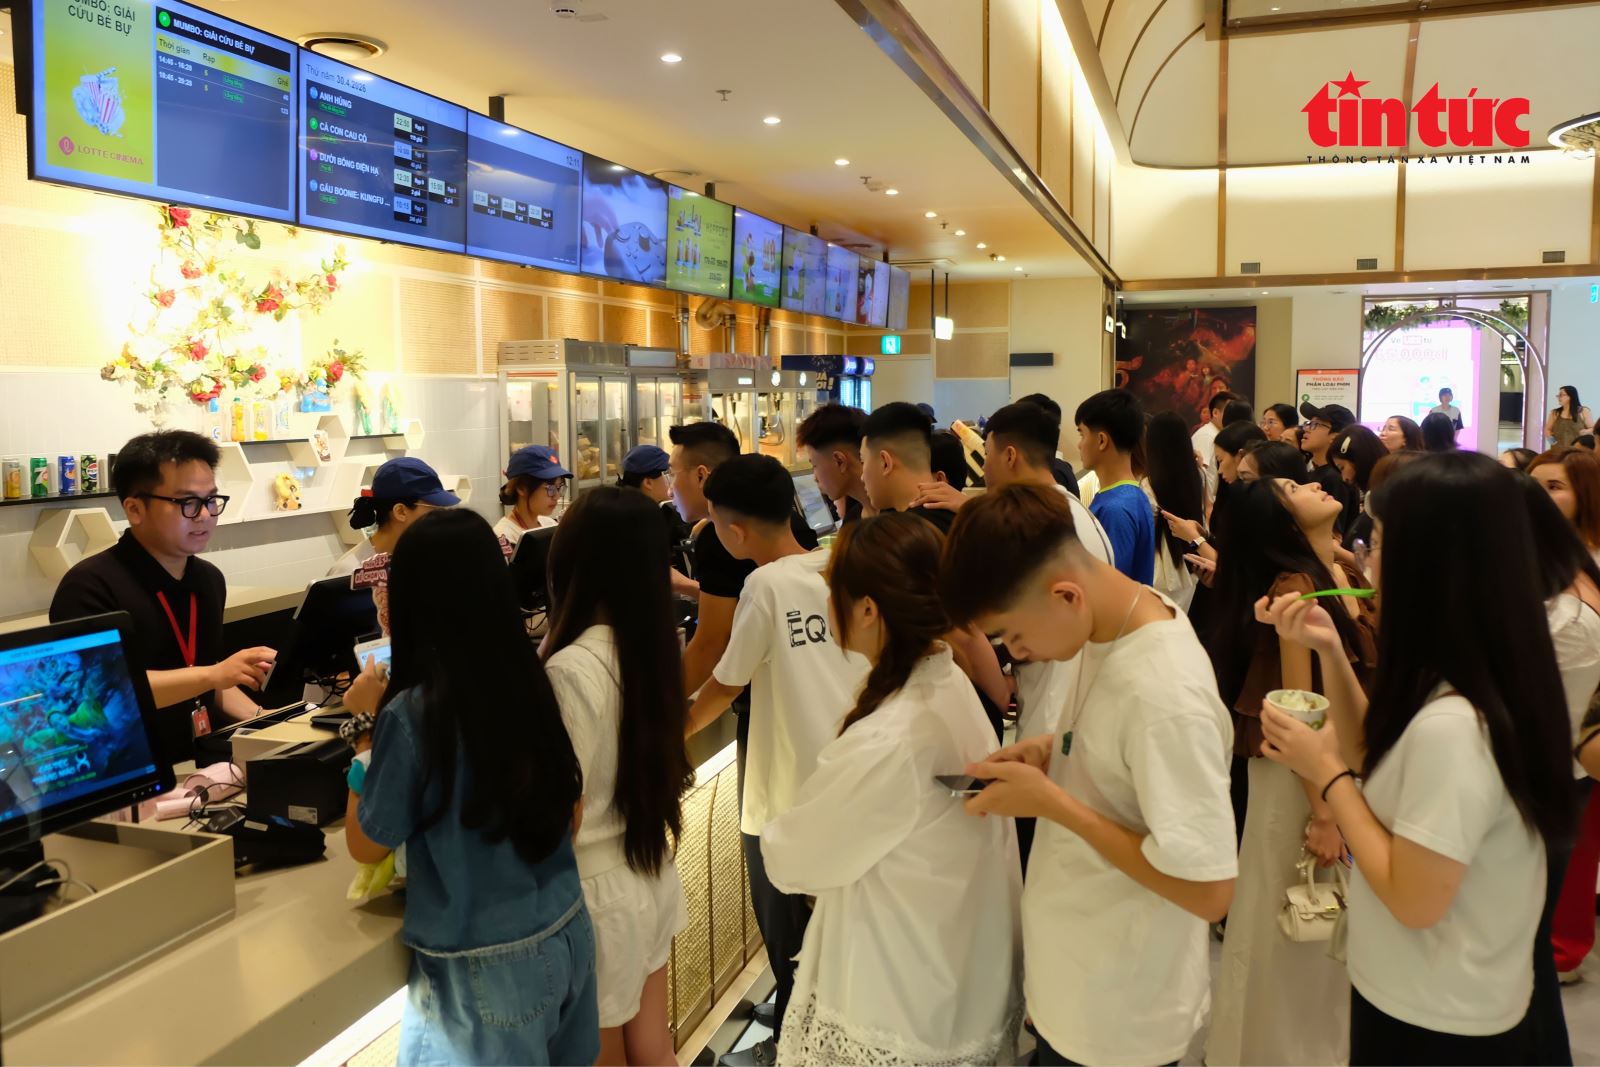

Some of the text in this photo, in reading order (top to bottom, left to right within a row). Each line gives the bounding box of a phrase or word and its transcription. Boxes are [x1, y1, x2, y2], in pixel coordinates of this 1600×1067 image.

[114, 6, 135, 21] GIẢI
[97, 14, 112, 28] BÉ
[115, 21, 132, 37] BỰ
[173, 18, 203, 36] MUMBO:
[320, 91, 334, 104] ANH
[78, 144, 109, 159] LOTTE
[360, 192, 384, 205] KUNGFU
[786, 610, 830, 648] EQ
